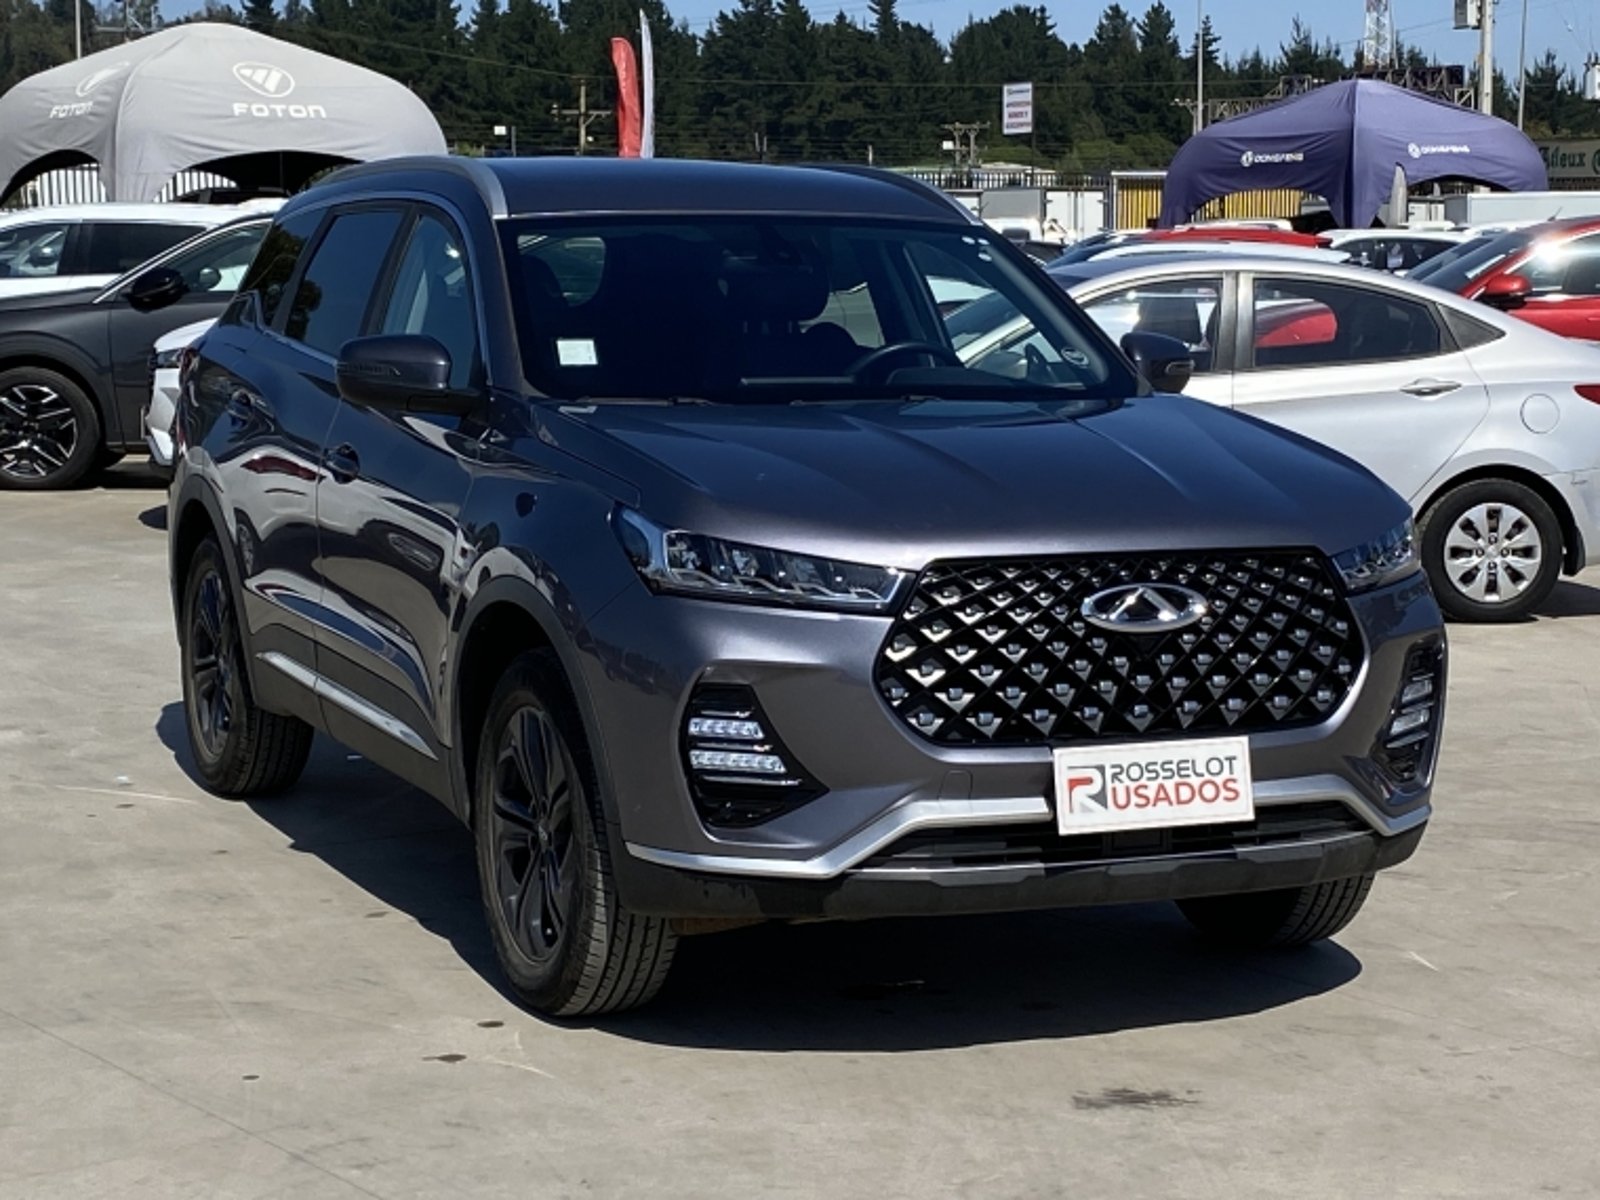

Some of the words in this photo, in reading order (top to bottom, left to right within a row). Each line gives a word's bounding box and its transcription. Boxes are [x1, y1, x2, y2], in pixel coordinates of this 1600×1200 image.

[49, 101, 94, 119] FOTON
[232, 102, 327, 119] FOTON
[1110, 756, 1237, 784] ROSSELOT
[1112, 778, 1240, 810] USADOS
